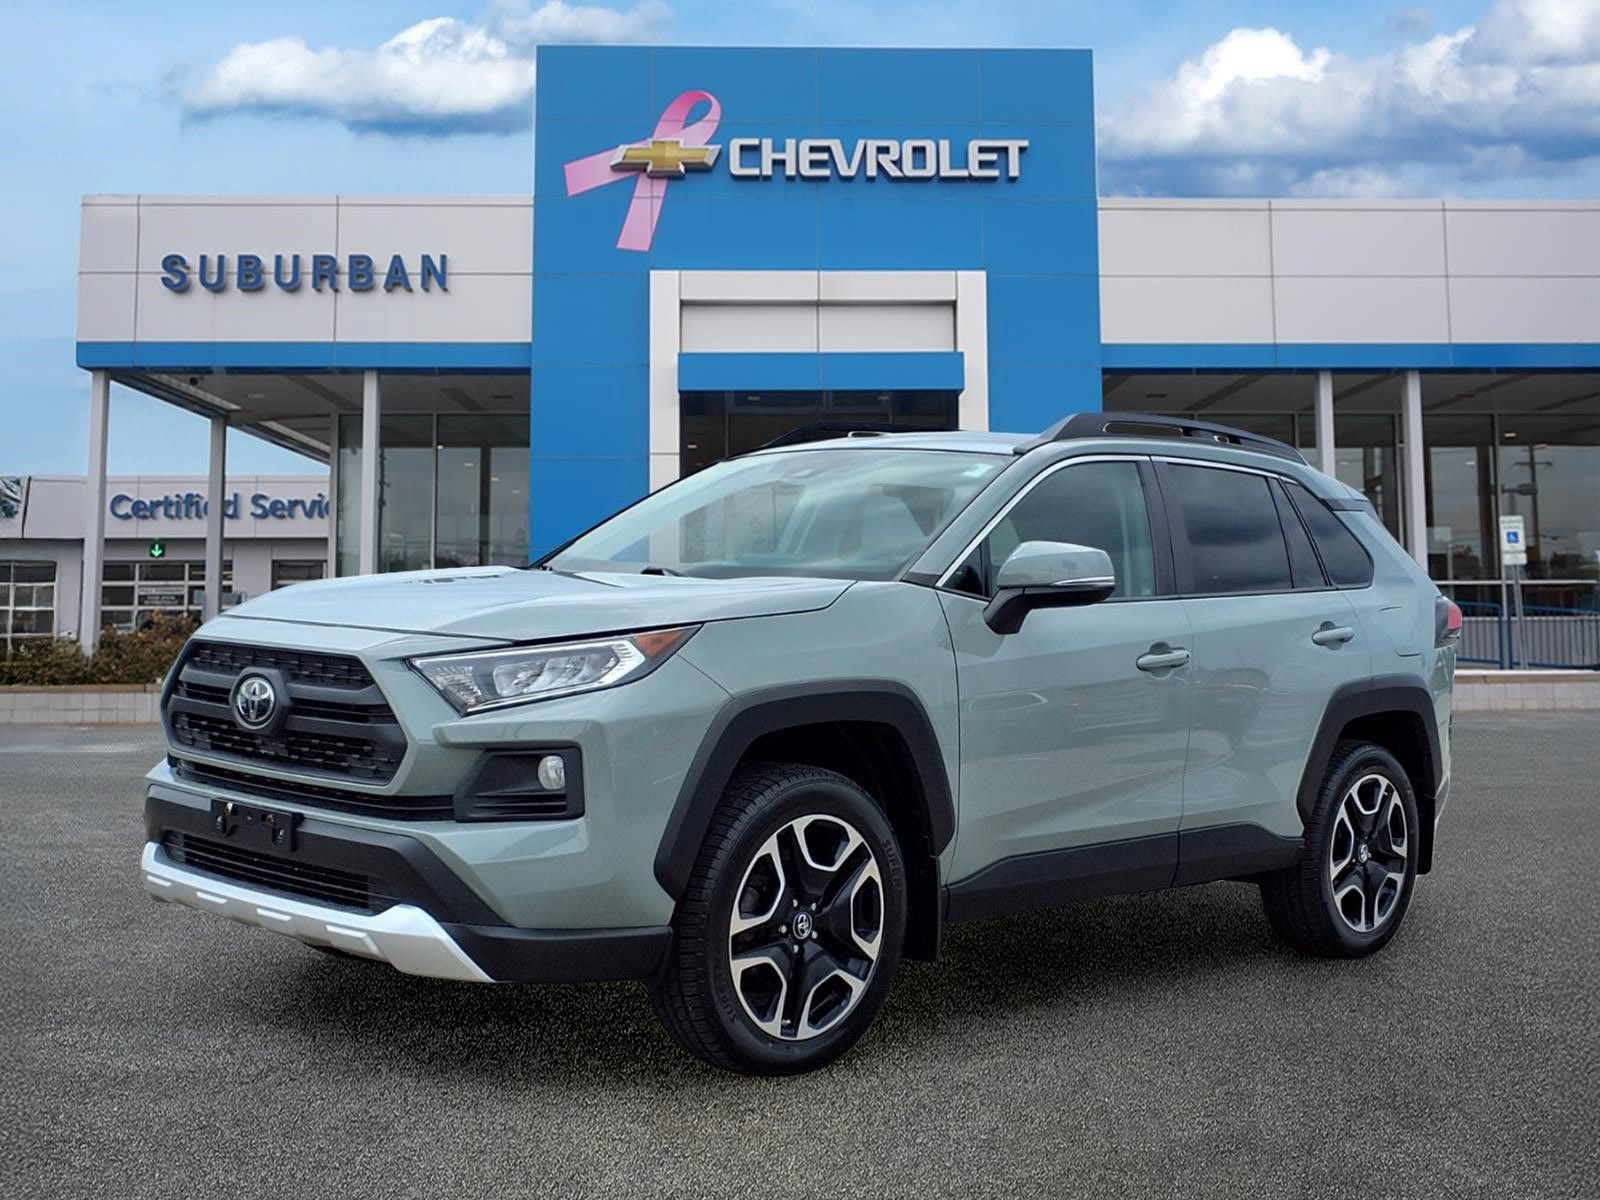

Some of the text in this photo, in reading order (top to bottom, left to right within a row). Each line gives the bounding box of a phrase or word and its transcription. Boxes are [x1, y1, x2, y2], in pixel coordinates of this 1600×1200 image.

[729, 137, 1029, 178] CHEVROLET
[161, 254, 448, 292] SUBURBAN
[110, 493, 240, 520] Certifid
